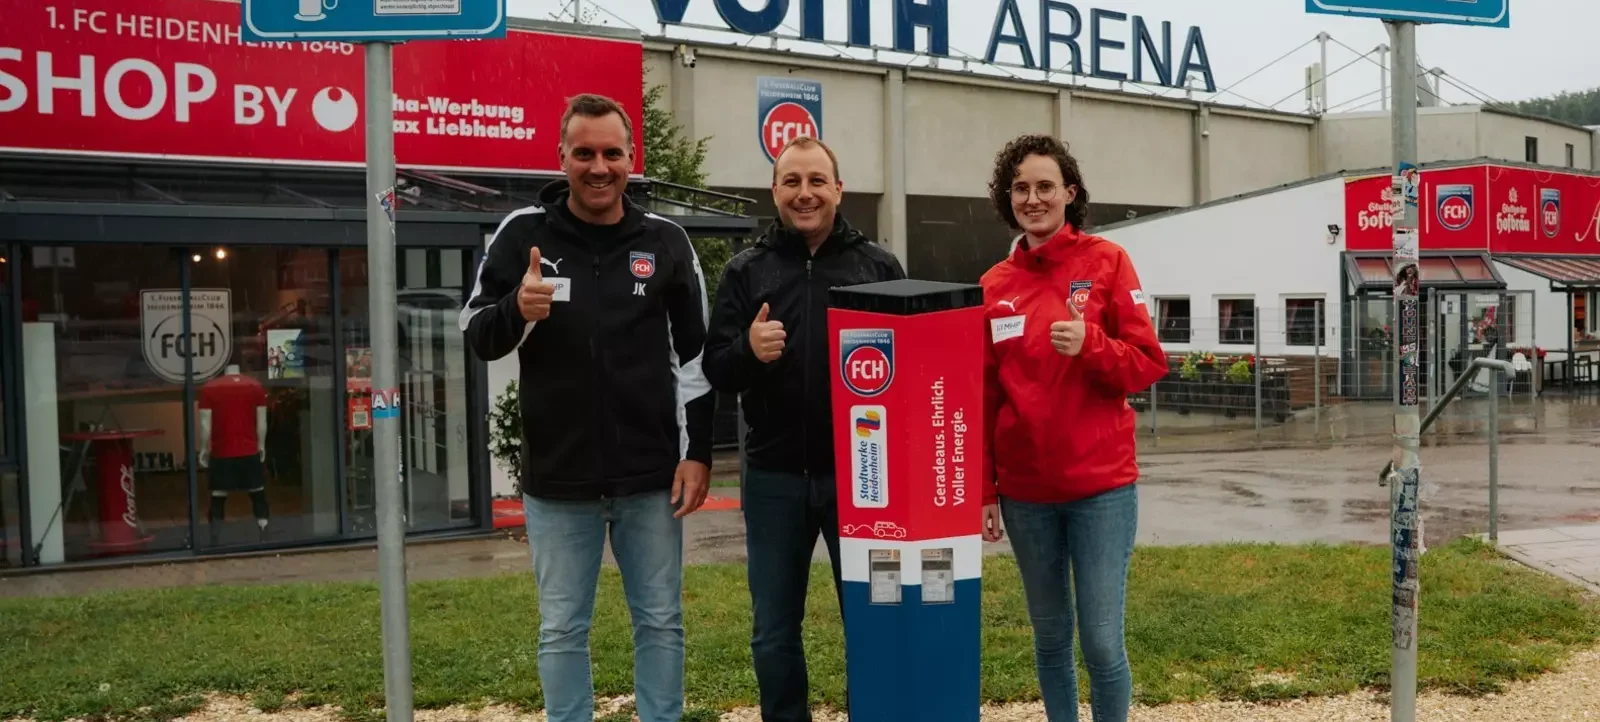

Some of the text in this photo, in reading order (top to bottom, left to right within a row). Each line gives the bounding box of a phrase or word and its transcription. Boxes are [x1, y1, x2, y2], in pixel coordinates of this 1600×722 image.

[46, 6, 66, 30] 1.
[73, 9, 108, 34] FC
[116, 14, 293, 51] HEIDENH
[653, 0, 1217, 93] ITH ARENA
[0, 47, 298, 127] SHOP BY
[392, 93, 524, 123] ha-Werbung
[392, 117, 536, 140] ax Liebhaber
[1443, 204, 1467, 219] FCH
[1544, 211, 1557, 225] FCH
[635, 263, 650, 272] FCH
[633, 282, 646, 297] JK
[161, 332, 216, 359] FCH
[851, 360, 884, 379] FCH
[930, 376, 946, 507] Geradeaus. Ehrlich.
[950, 407, 967, 506] Voller Energie.
[858, 440, 869, 500] Stadtwerke
[869, 442, 879, 503] Heidenheim
